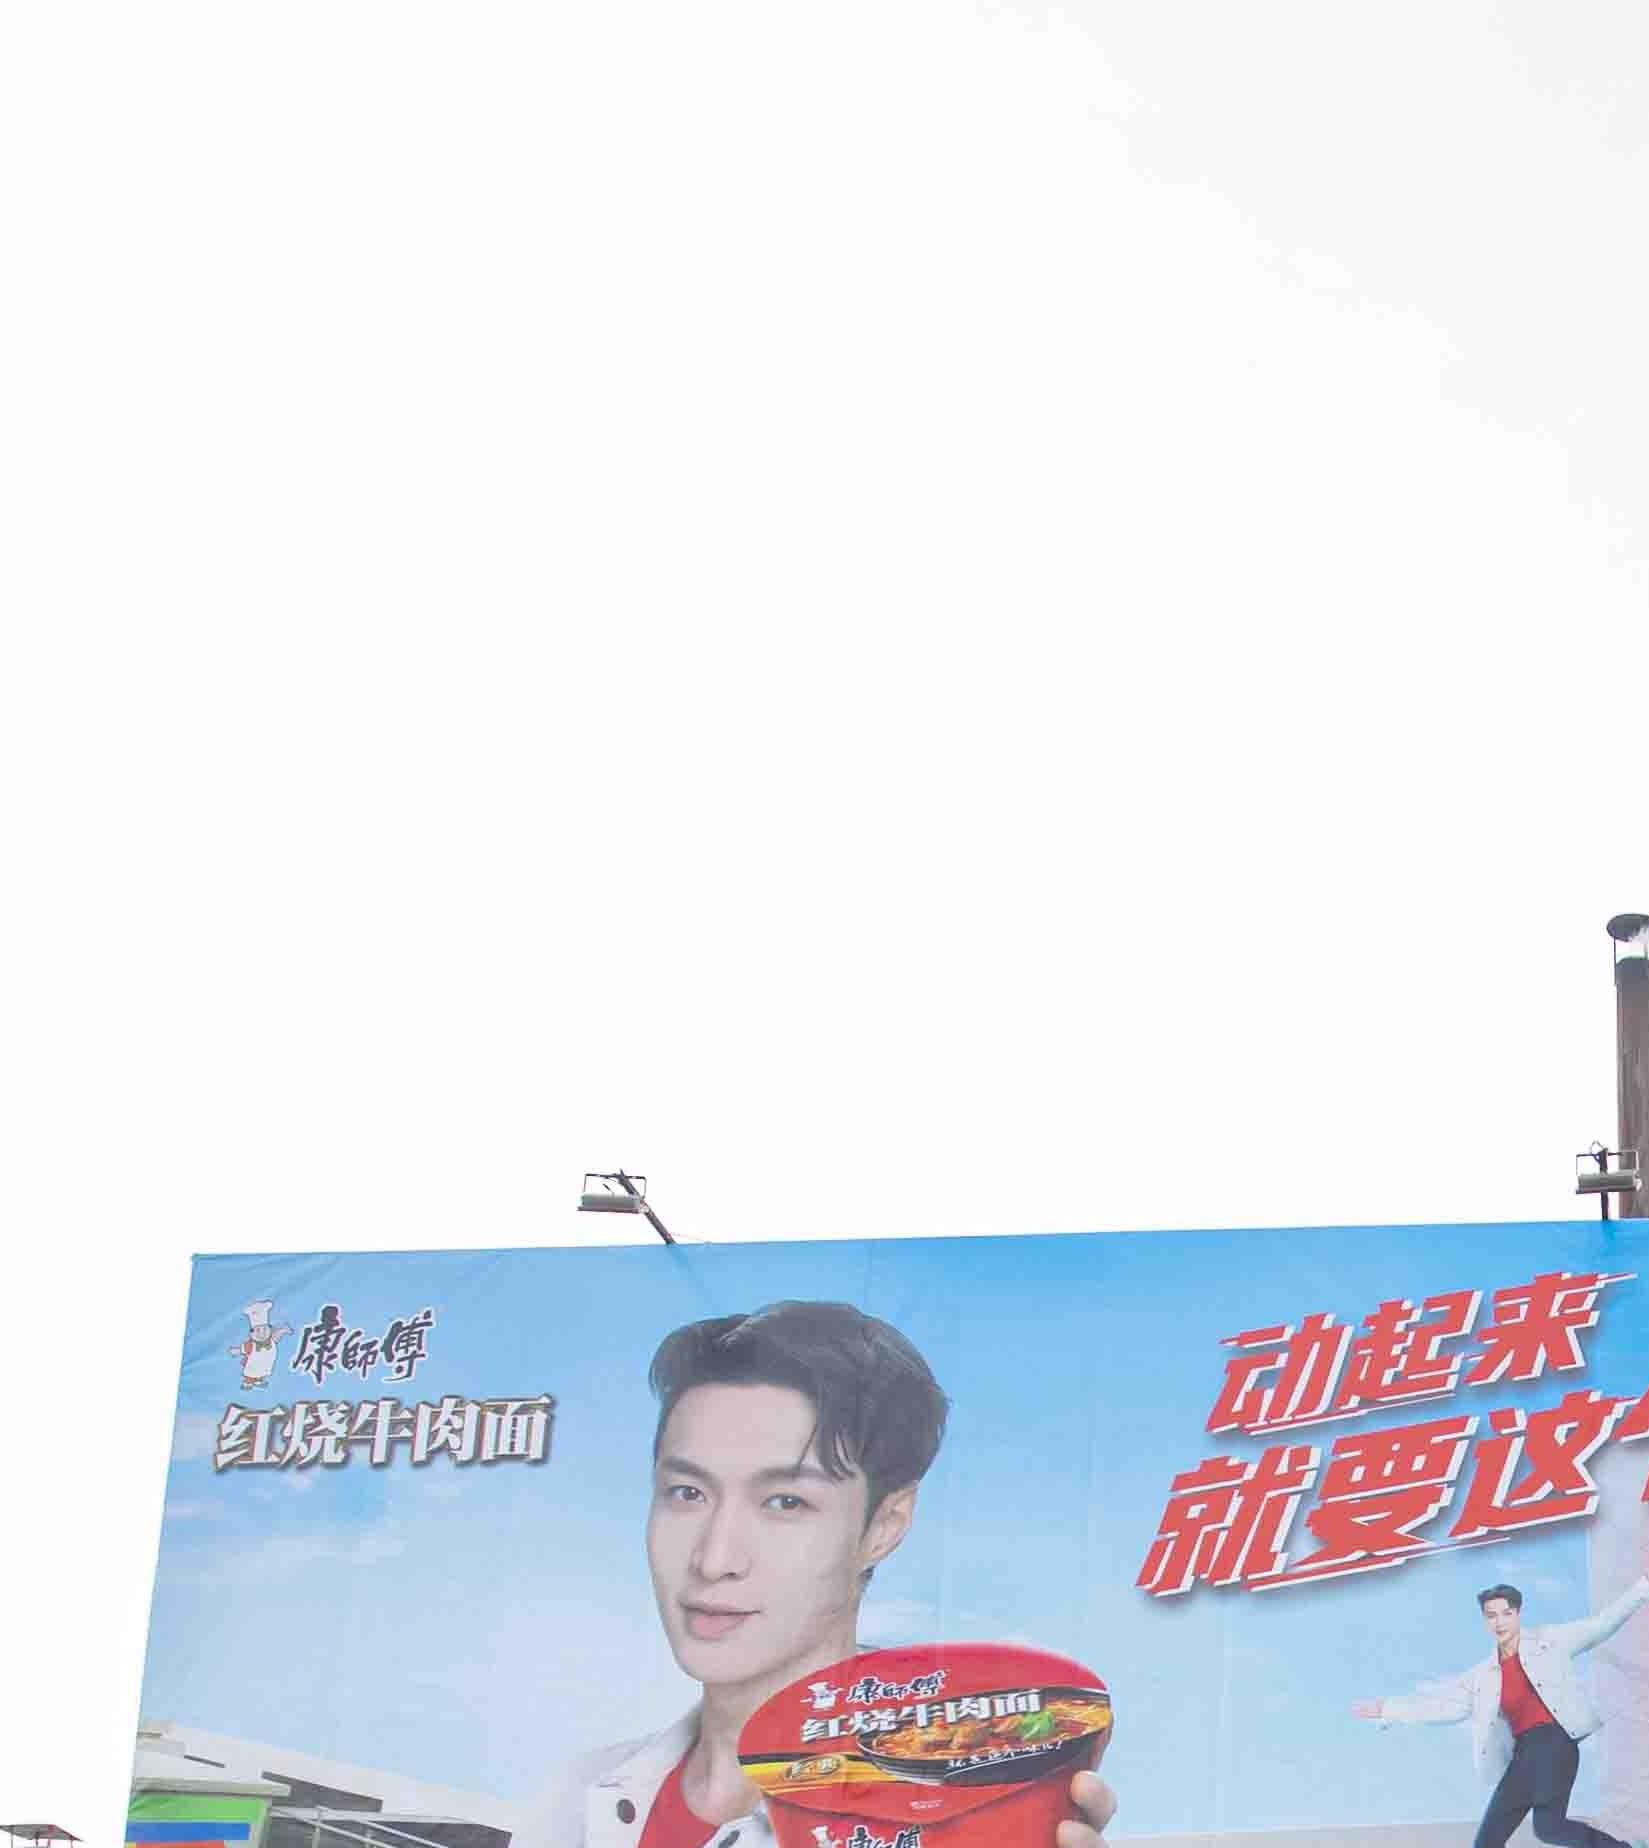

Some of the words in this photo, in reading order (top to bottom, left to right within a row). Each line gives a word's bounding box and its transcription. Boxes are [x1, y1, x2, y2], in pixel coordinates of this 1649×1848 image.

[1206, 1271, 1637, 1435] 动起来
[215, 1396, 555, 1469] 红烧牛肉面
[800, 1689, 1042, 1743] 红烧牛肉面
